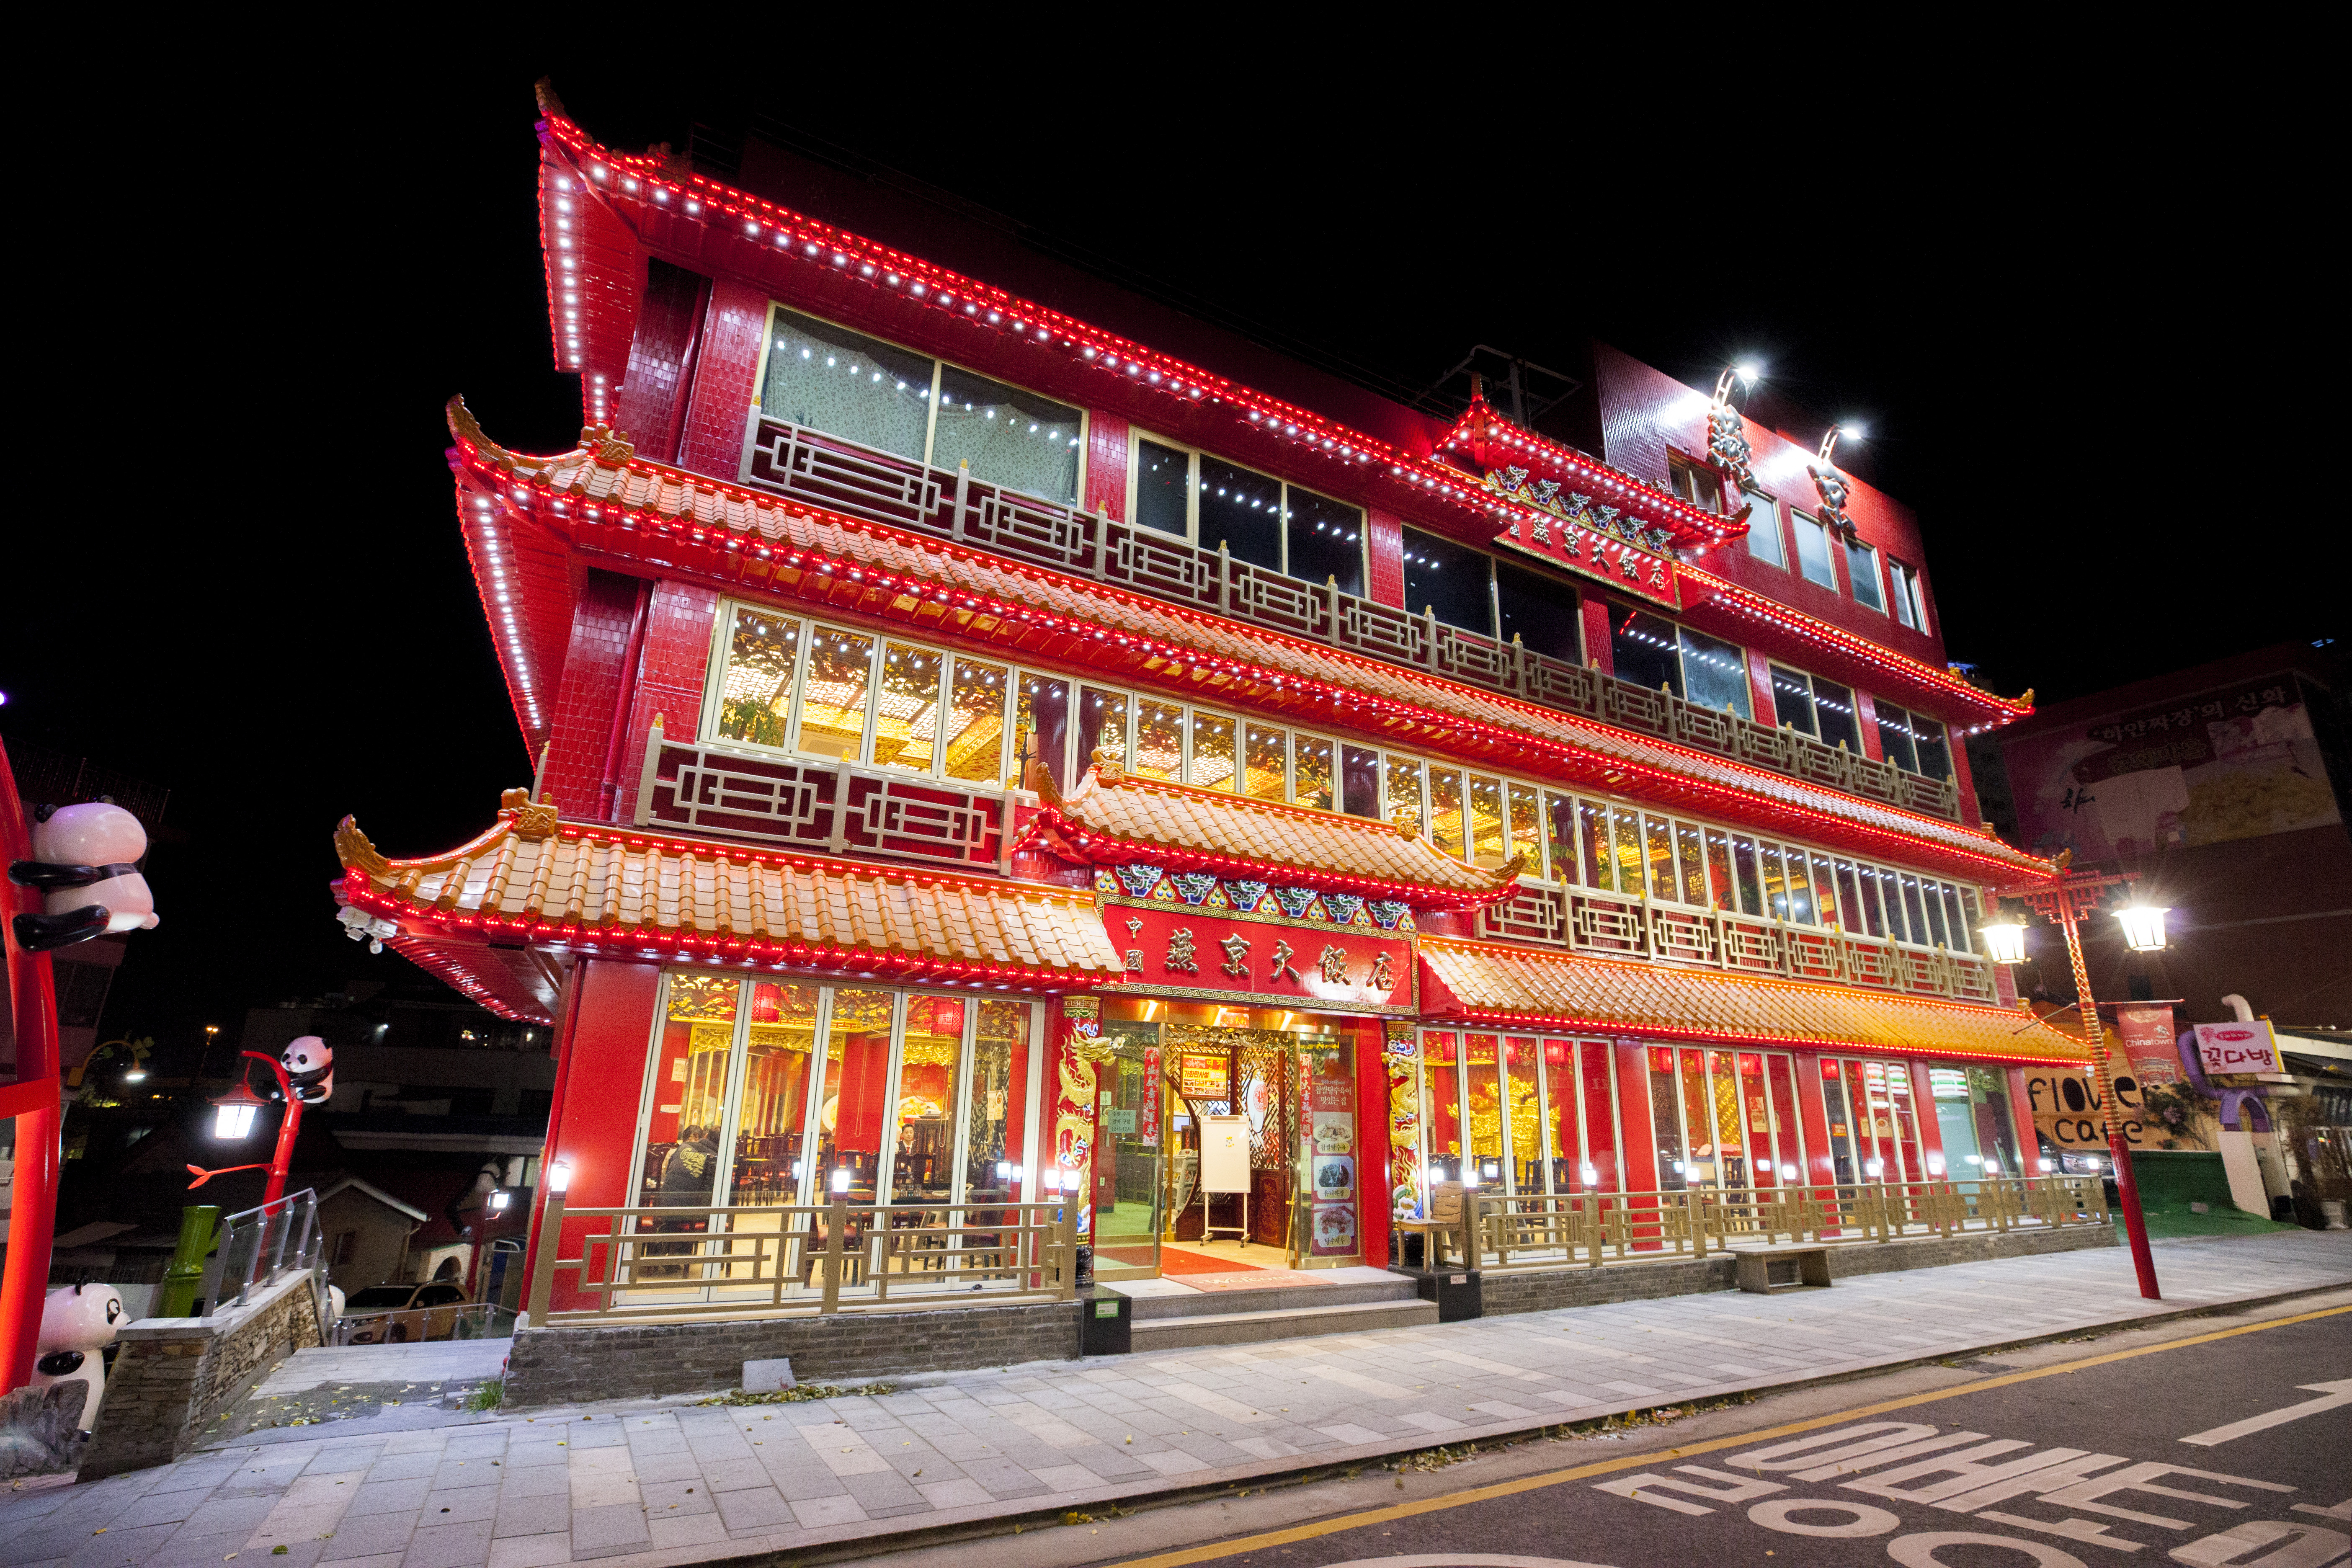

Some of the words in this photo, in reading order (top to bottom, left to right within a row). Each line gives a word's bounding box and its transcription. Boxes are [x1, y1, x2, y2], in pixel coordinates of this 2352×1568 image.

[2236, 686, 2287, 711] 신화
[1124, 916, 1144, 972] 中國
[1164, 927, 1395, 991] 燕京大飯店
[2126, 1039, 2173, 1047] Chinatown
[2202, 1047, 2272, 1066] 꽃다방
[1316, 1085, 1351, 1096] 찹쌀탕수육이
[1320, 1096, 1340, 1105] 맛있는
[1341, 1096, 1346, 1106] 집
[1192, 1275, 1303, 1284] Welcome
